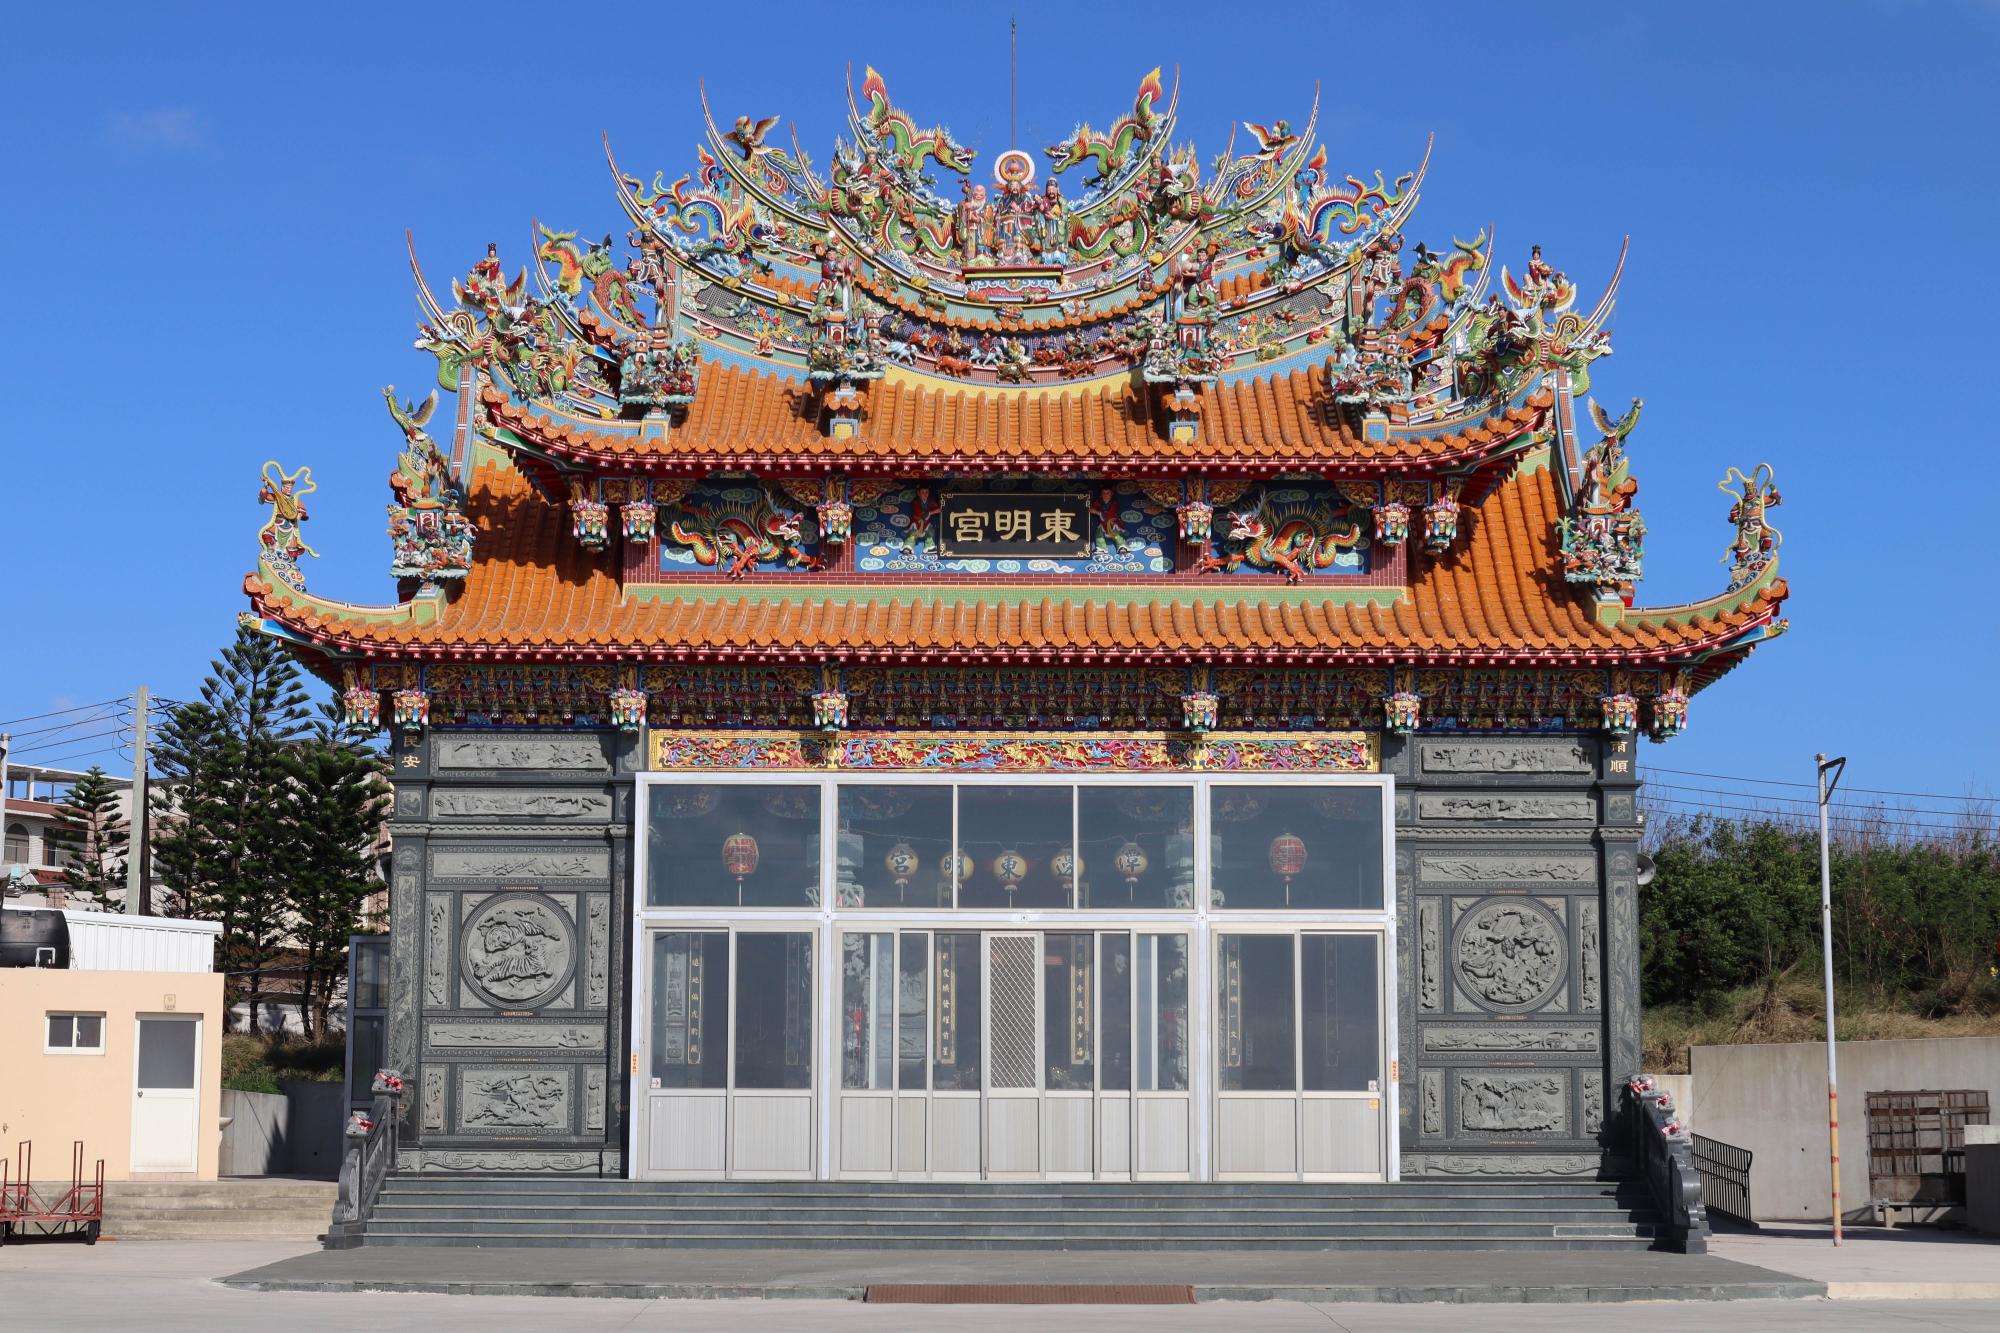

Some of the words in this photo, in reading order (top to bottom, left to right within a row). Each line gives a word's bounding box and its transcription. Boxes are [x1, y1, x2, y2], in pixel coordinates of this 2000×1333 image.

[949, 508, 1081, 544] 東明宮
[401, 735, 421, 768] 民安
[1610, 741, 1629, 773] 雨順
[890, 852, 914, 874] 宮
[1000, 855, 1021, 879] 東
